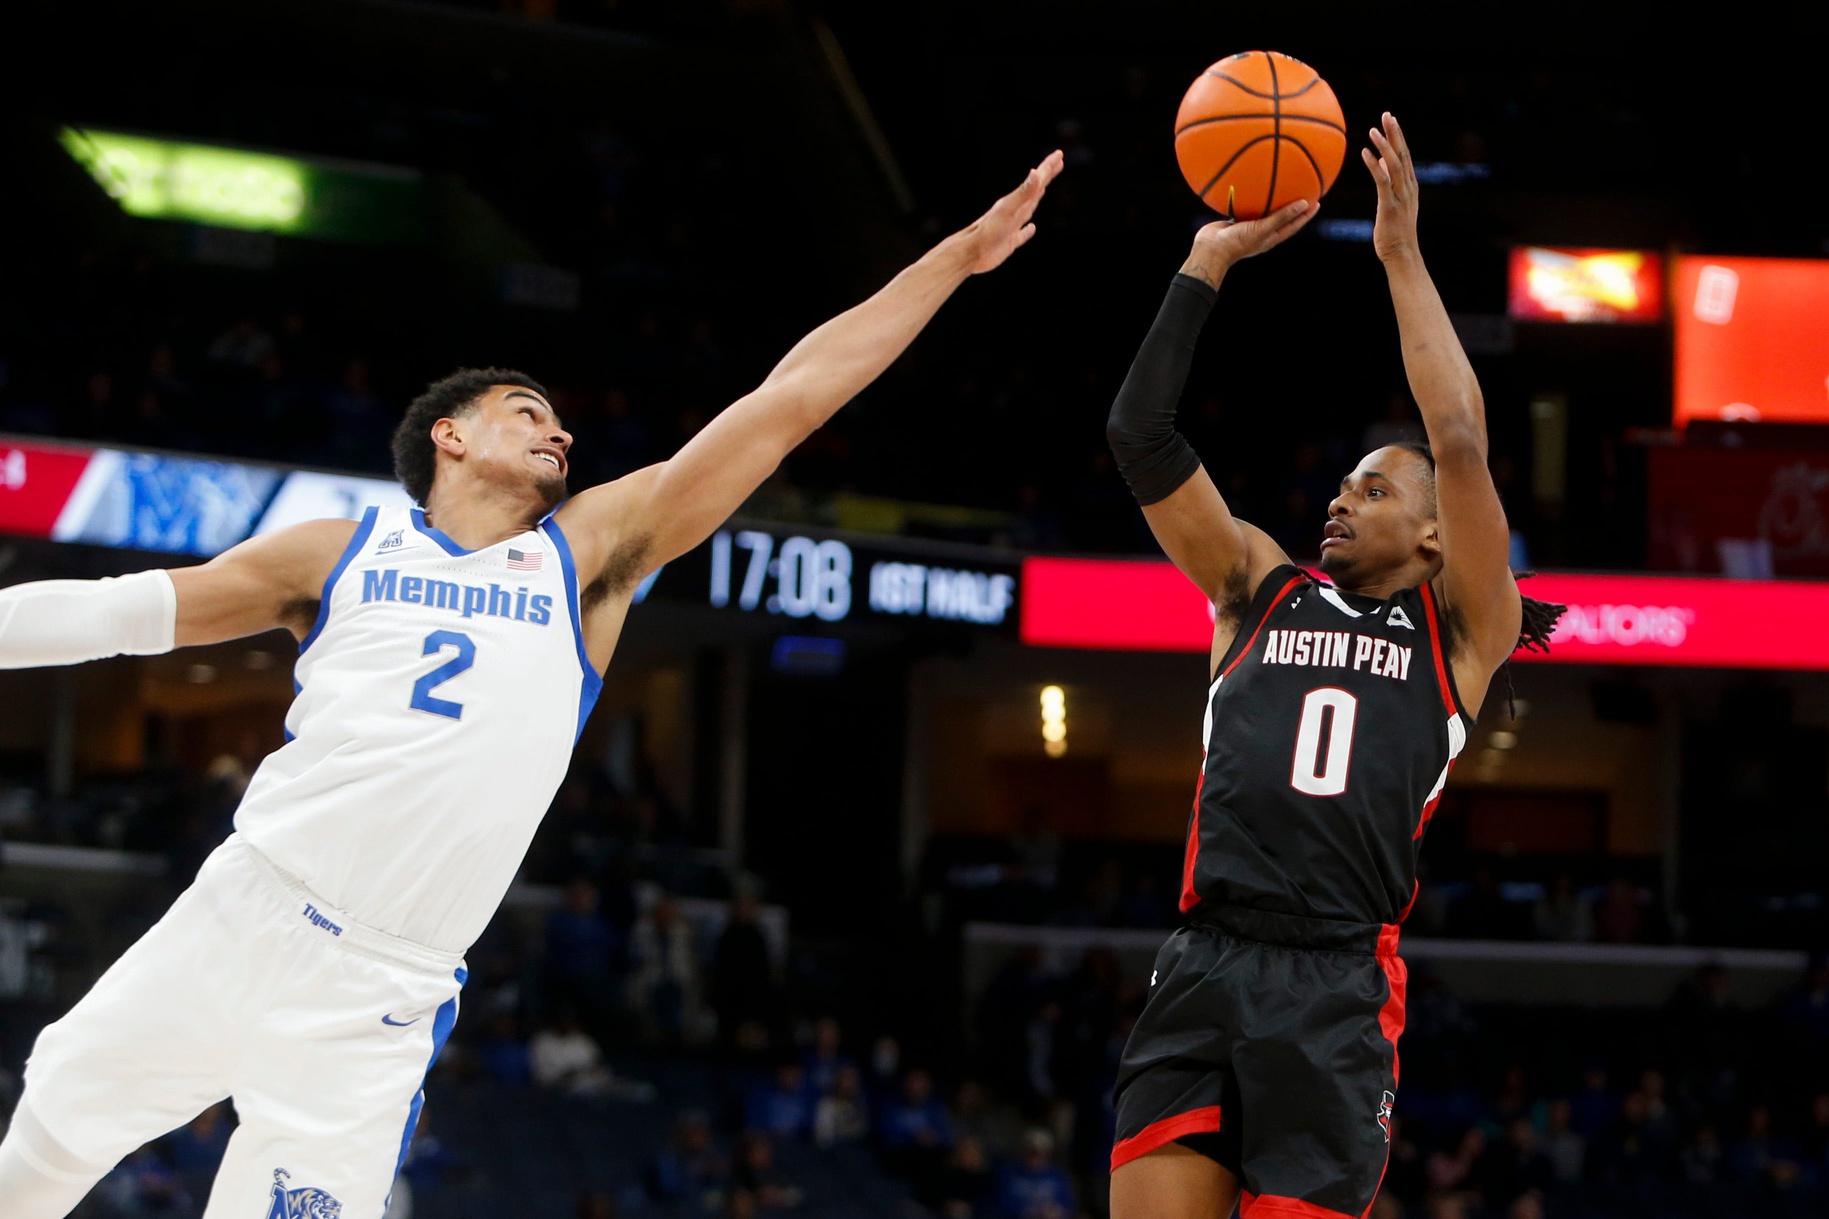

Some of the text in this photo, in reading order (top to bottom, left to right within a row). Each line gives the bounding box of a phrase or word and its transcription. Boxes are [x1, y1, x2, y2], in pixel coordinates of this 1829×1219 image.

[360, 568, 554, 627] Memphis
[711, 530, 852, 622] 17:08
[926, 567, 1015, 625] HALF
[1546, 603, 1690, 647] ALTORS
[408, 629, 477, 722] 2
[1262, 629, 1413, 681] AUSTIN PEAY
[1289, 685, 1359, 798] 0
[302, 902, 343, 937] Tigers
